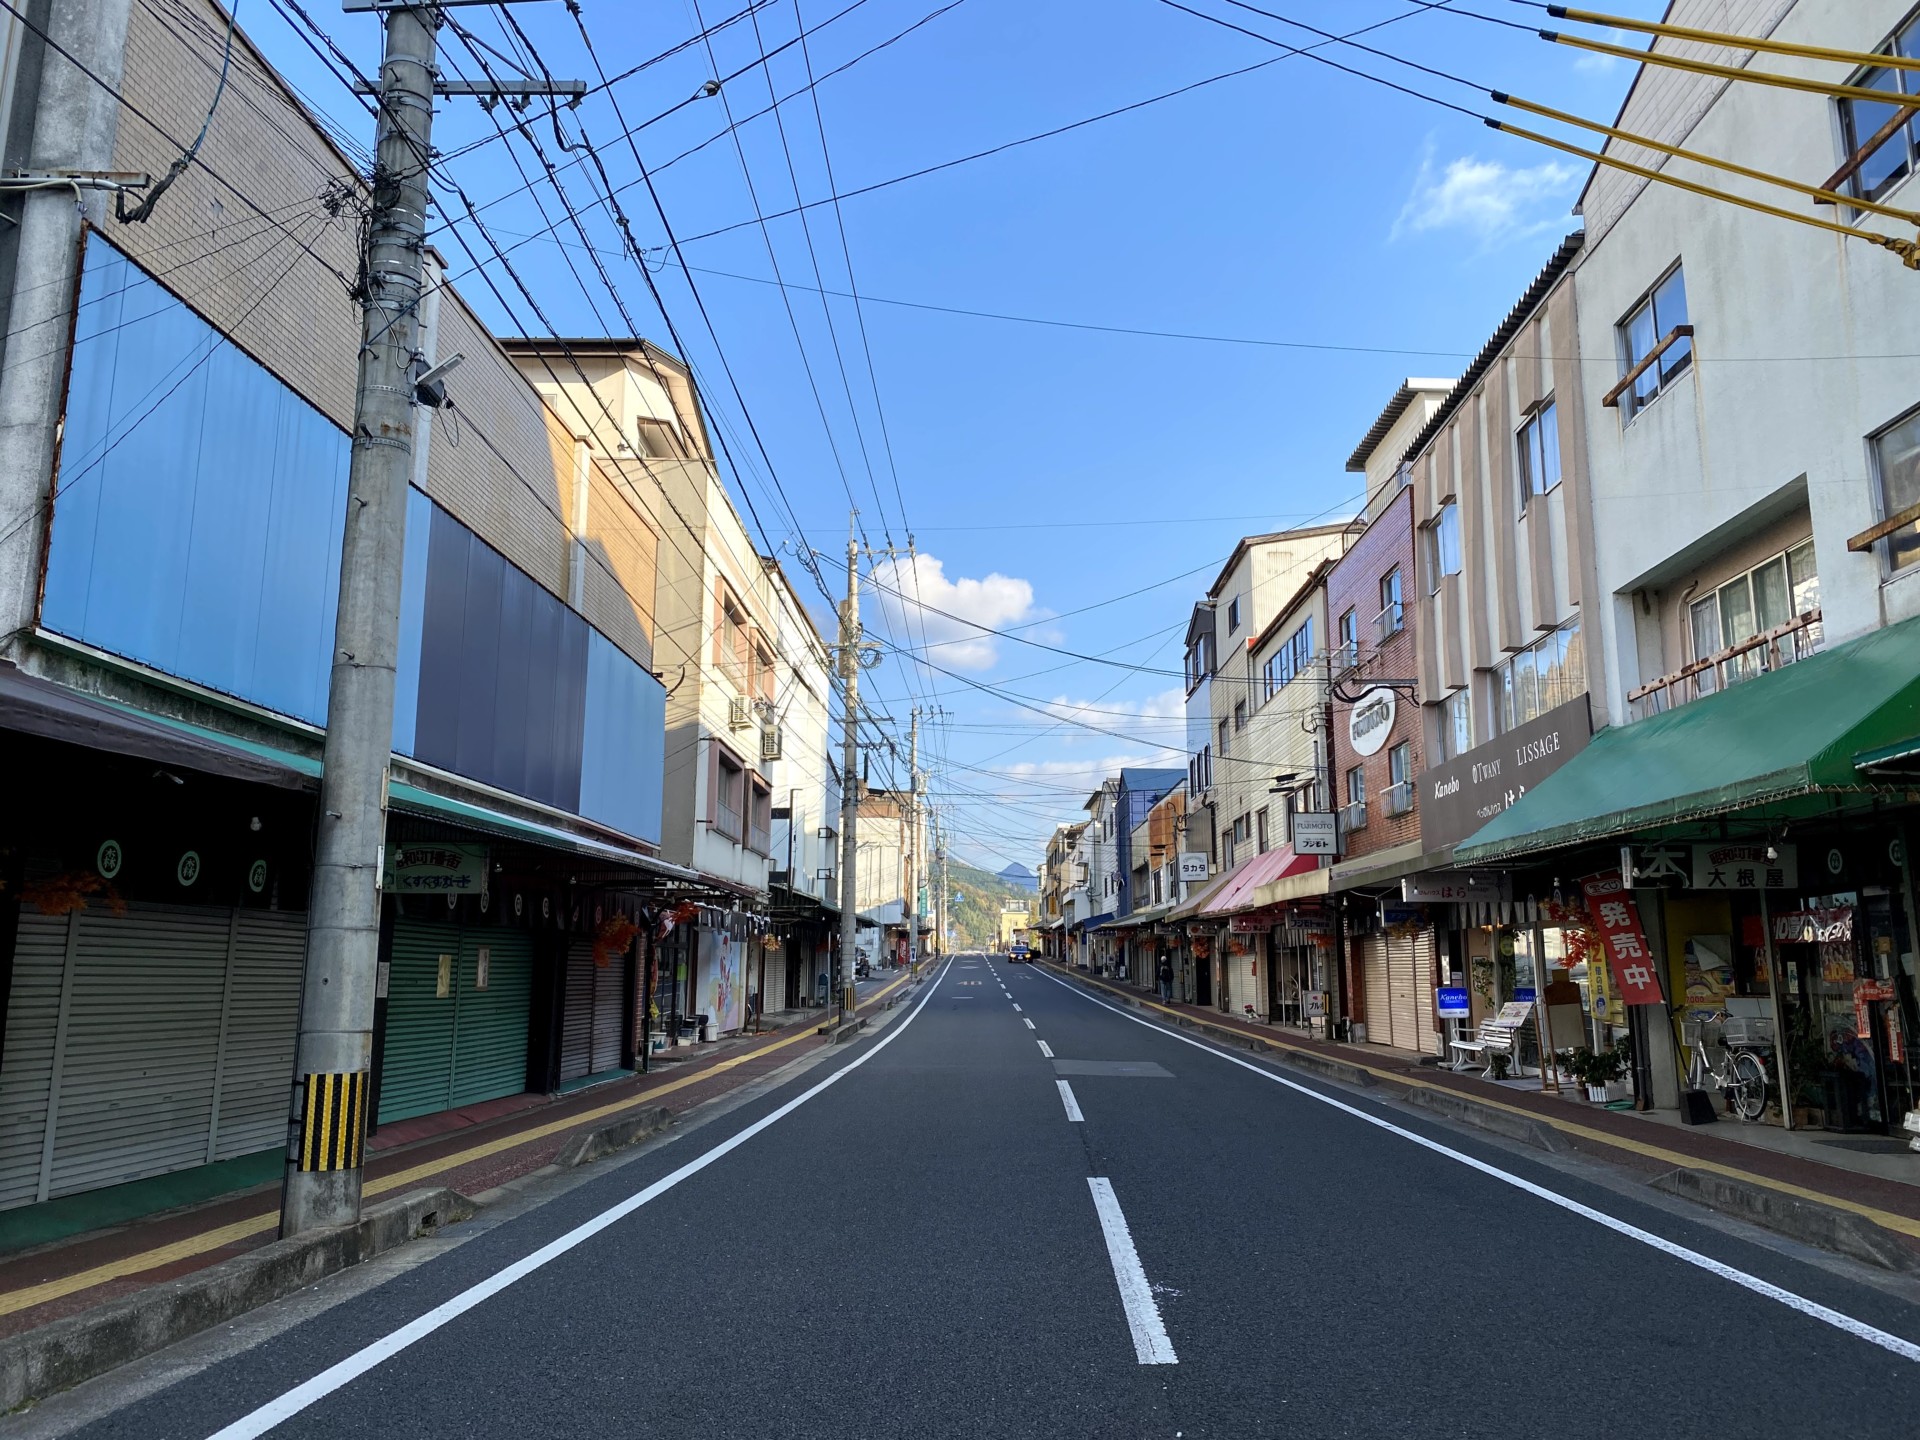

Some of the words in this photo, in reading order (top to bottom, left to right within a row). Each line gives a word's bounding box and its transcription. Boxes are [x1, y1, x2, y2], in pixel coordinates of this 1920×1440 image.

[1434, 775, 1460, 800] Kanebo
[1516, 731, 1561, 767] LISSAGE
[1296, 822, 1333, 830] FUJIMOTO
[1302, 840, 1329, 848] フジモト
[1182, 864, 1206, 872] タカタ
[1708, 867, 1785, 887] 大根屋
[1441, 886, 1467, 899] はら
[1588, 880, 1619, 895] 宝くじ
[1599, 901, 1652, 991] 発売中
[1439, 993, 1468, 1001] Kanebo
